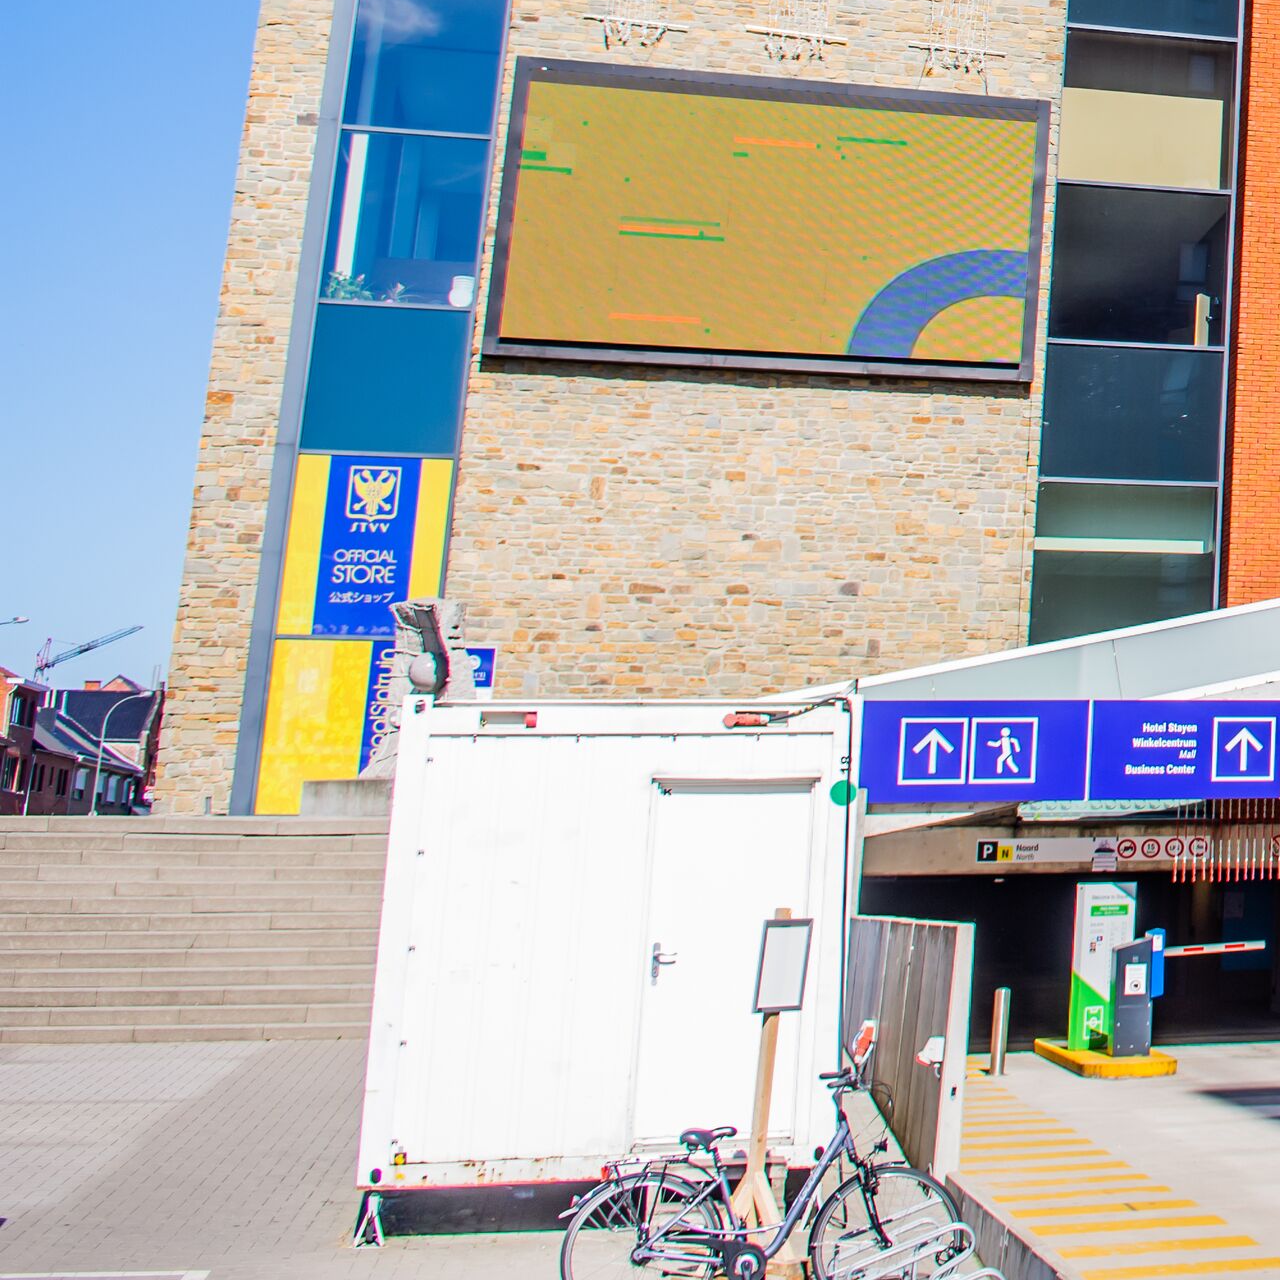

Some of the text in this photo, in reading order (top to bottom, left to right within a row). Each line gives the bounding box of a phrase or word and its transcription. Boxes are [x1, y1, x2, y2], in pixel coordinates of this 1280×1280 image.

[349, 521, 390, 533] STVV
[333, 548, 398, 564] OFFICIAL
[331, 565, 395, 585] STORE
[328, 591, 395, 604] 公式ショップ
[1142, 722, 1198, 735] Hotel Stayen
[1132, 737, 1197, 748] Winkelcentrum
[1178, 749, 1197, 759] Mall
[1125, 763, 1196, 774] Business Center
[982, 844, 994, 859] P
[1001, 848, 1010, 859] N
[1016, 843, 1039, 852] Noord
